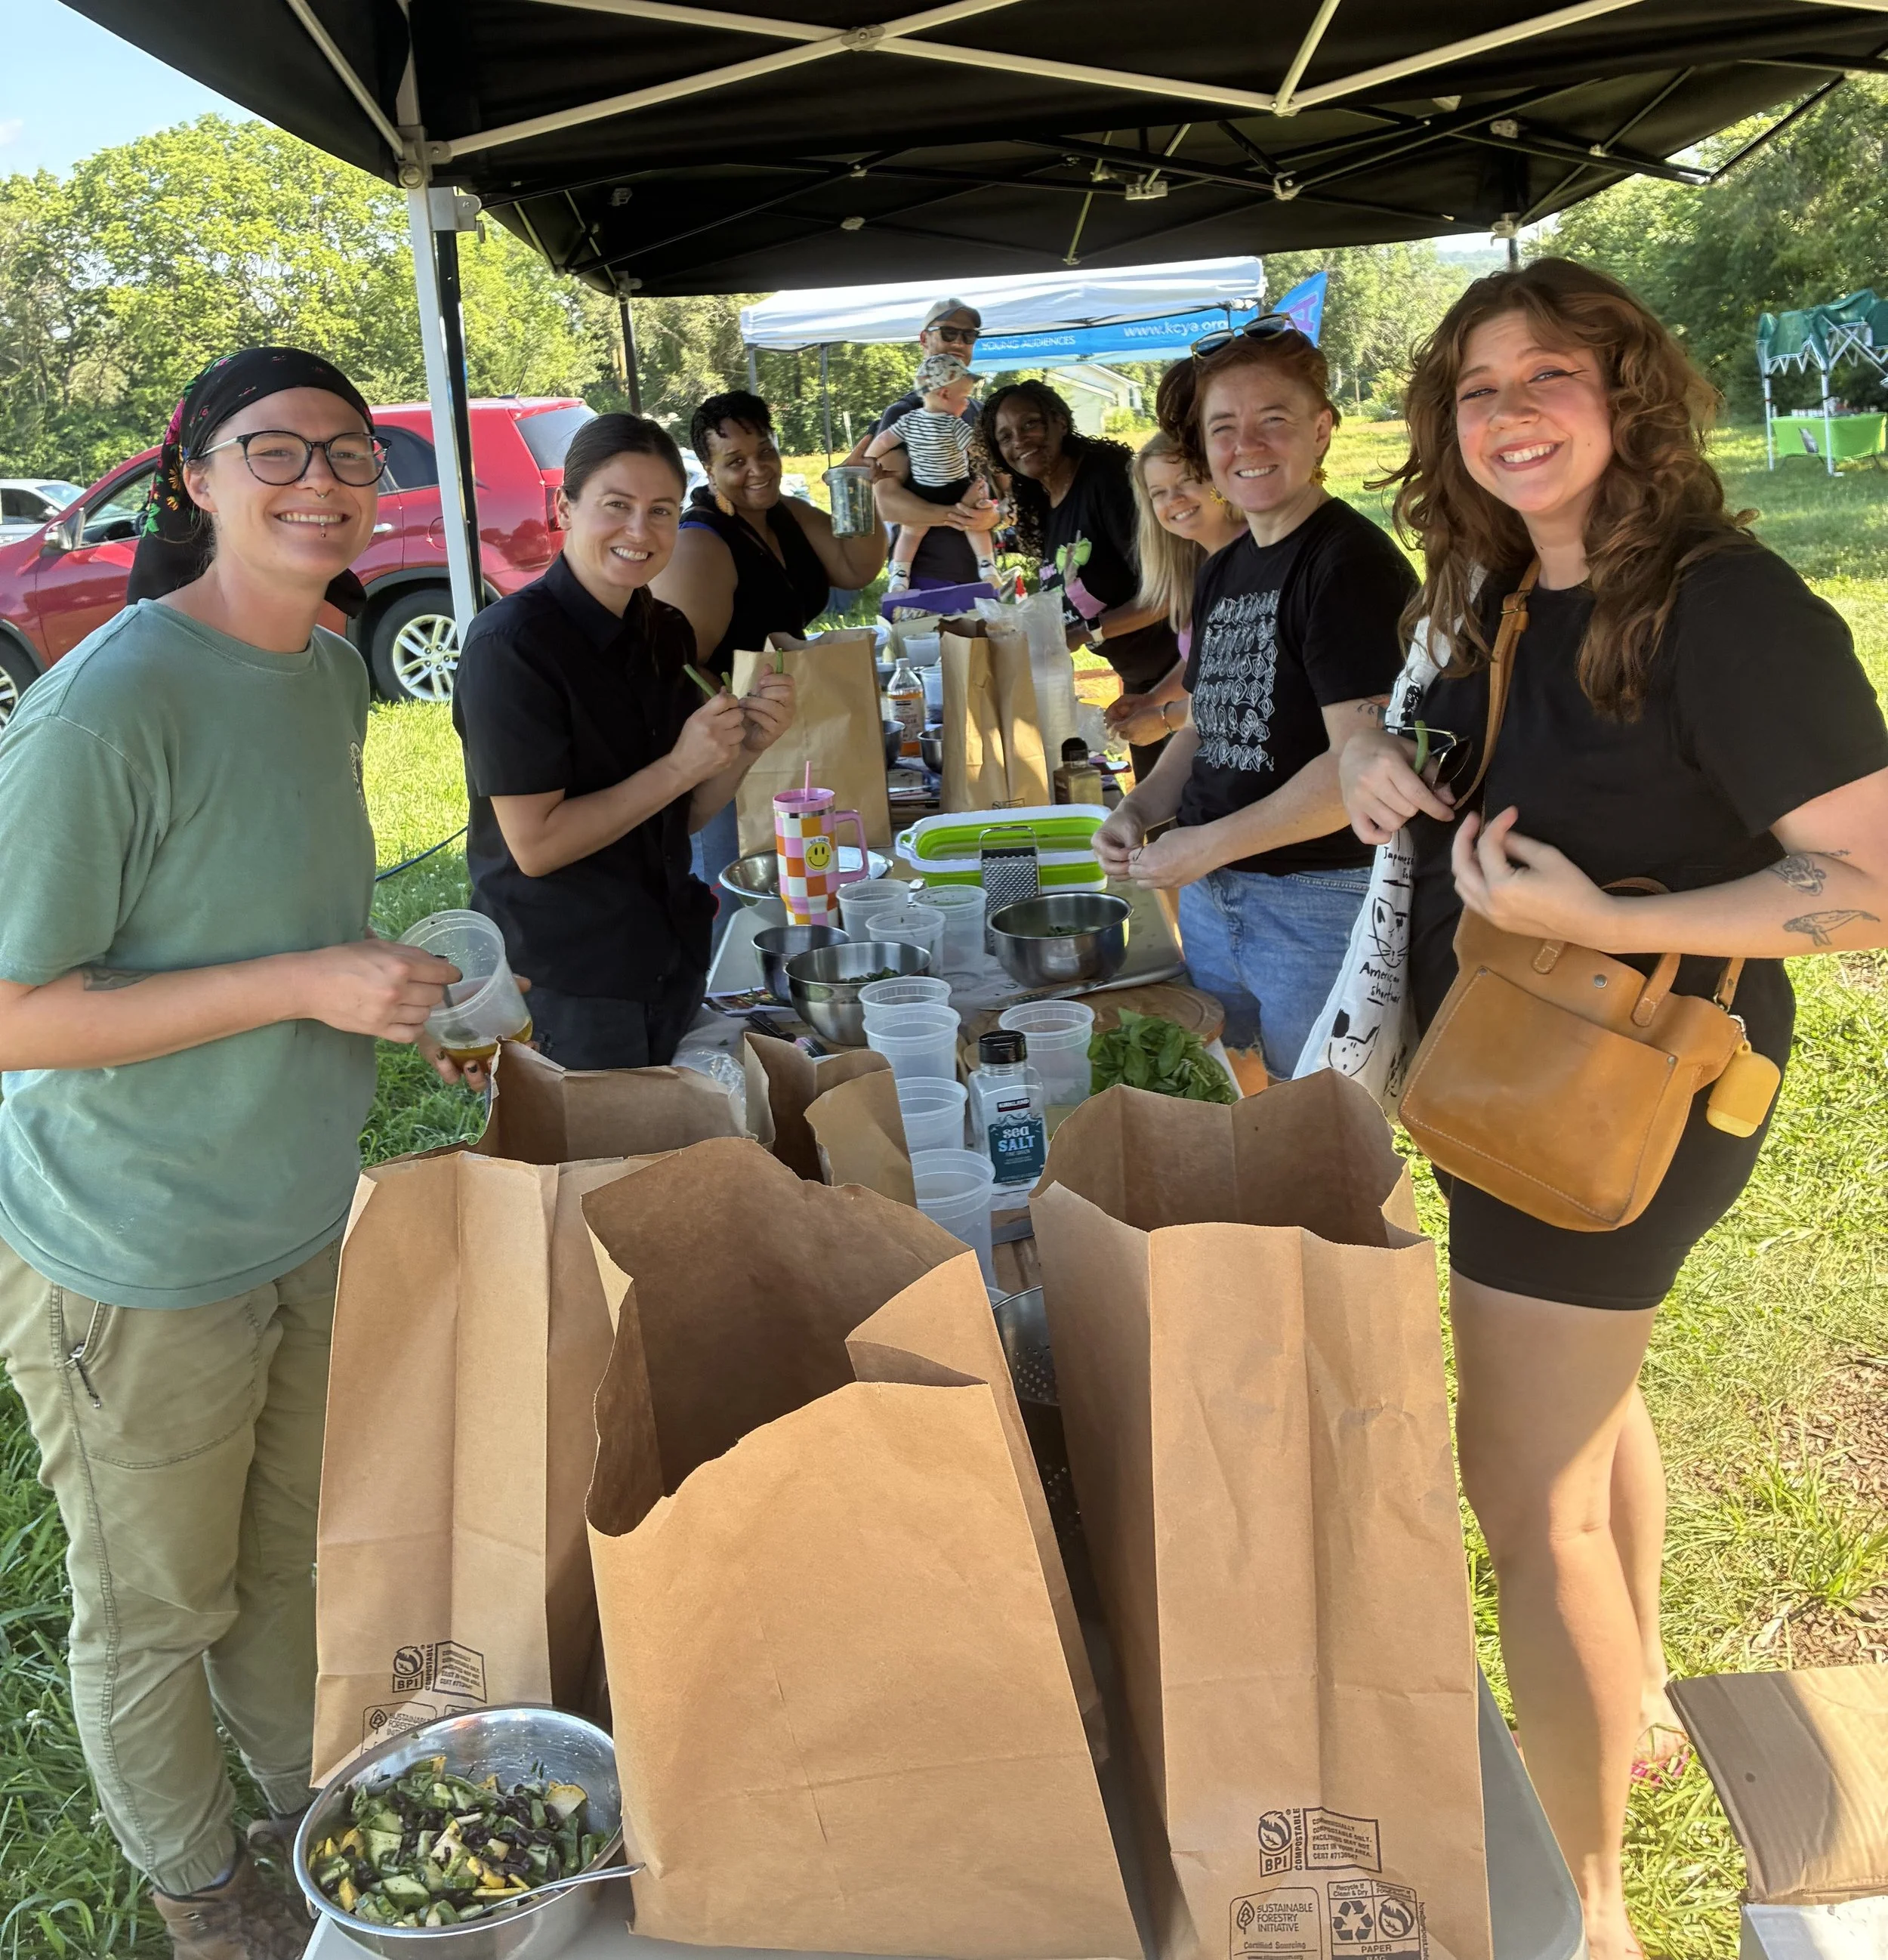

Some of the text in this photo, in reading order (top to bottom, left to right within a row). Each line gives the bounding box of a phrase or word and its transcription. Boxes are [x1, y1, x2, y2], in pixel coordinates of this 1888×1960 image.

[982, 335, 1076, 350] YOUNG AUDIENCES
[1359, 961, 1399, 983] American
[1002, 1125, 1030, 1139] sea
[998, 1135, 1035, 1153] SALT
[425, 1644, 433, 1691] COMPOSTABLE
[397, 1678, 418, 1690] BPI
[1293, 1807, 1303, 1871] COMPOSTABLE
[1265, 1856, 1287, 1872] BPI
[1257, 1903, 1313, 1913] SUSTAINABLE
[1257, 1913, 1298, 1923] FORESTRY
[1257, 1923, 1300, 1932] INITIATIVE
[1275, 1940, 1306, 1950] Sourcing
[1361, 1944, 1392, 1953] PAPER
